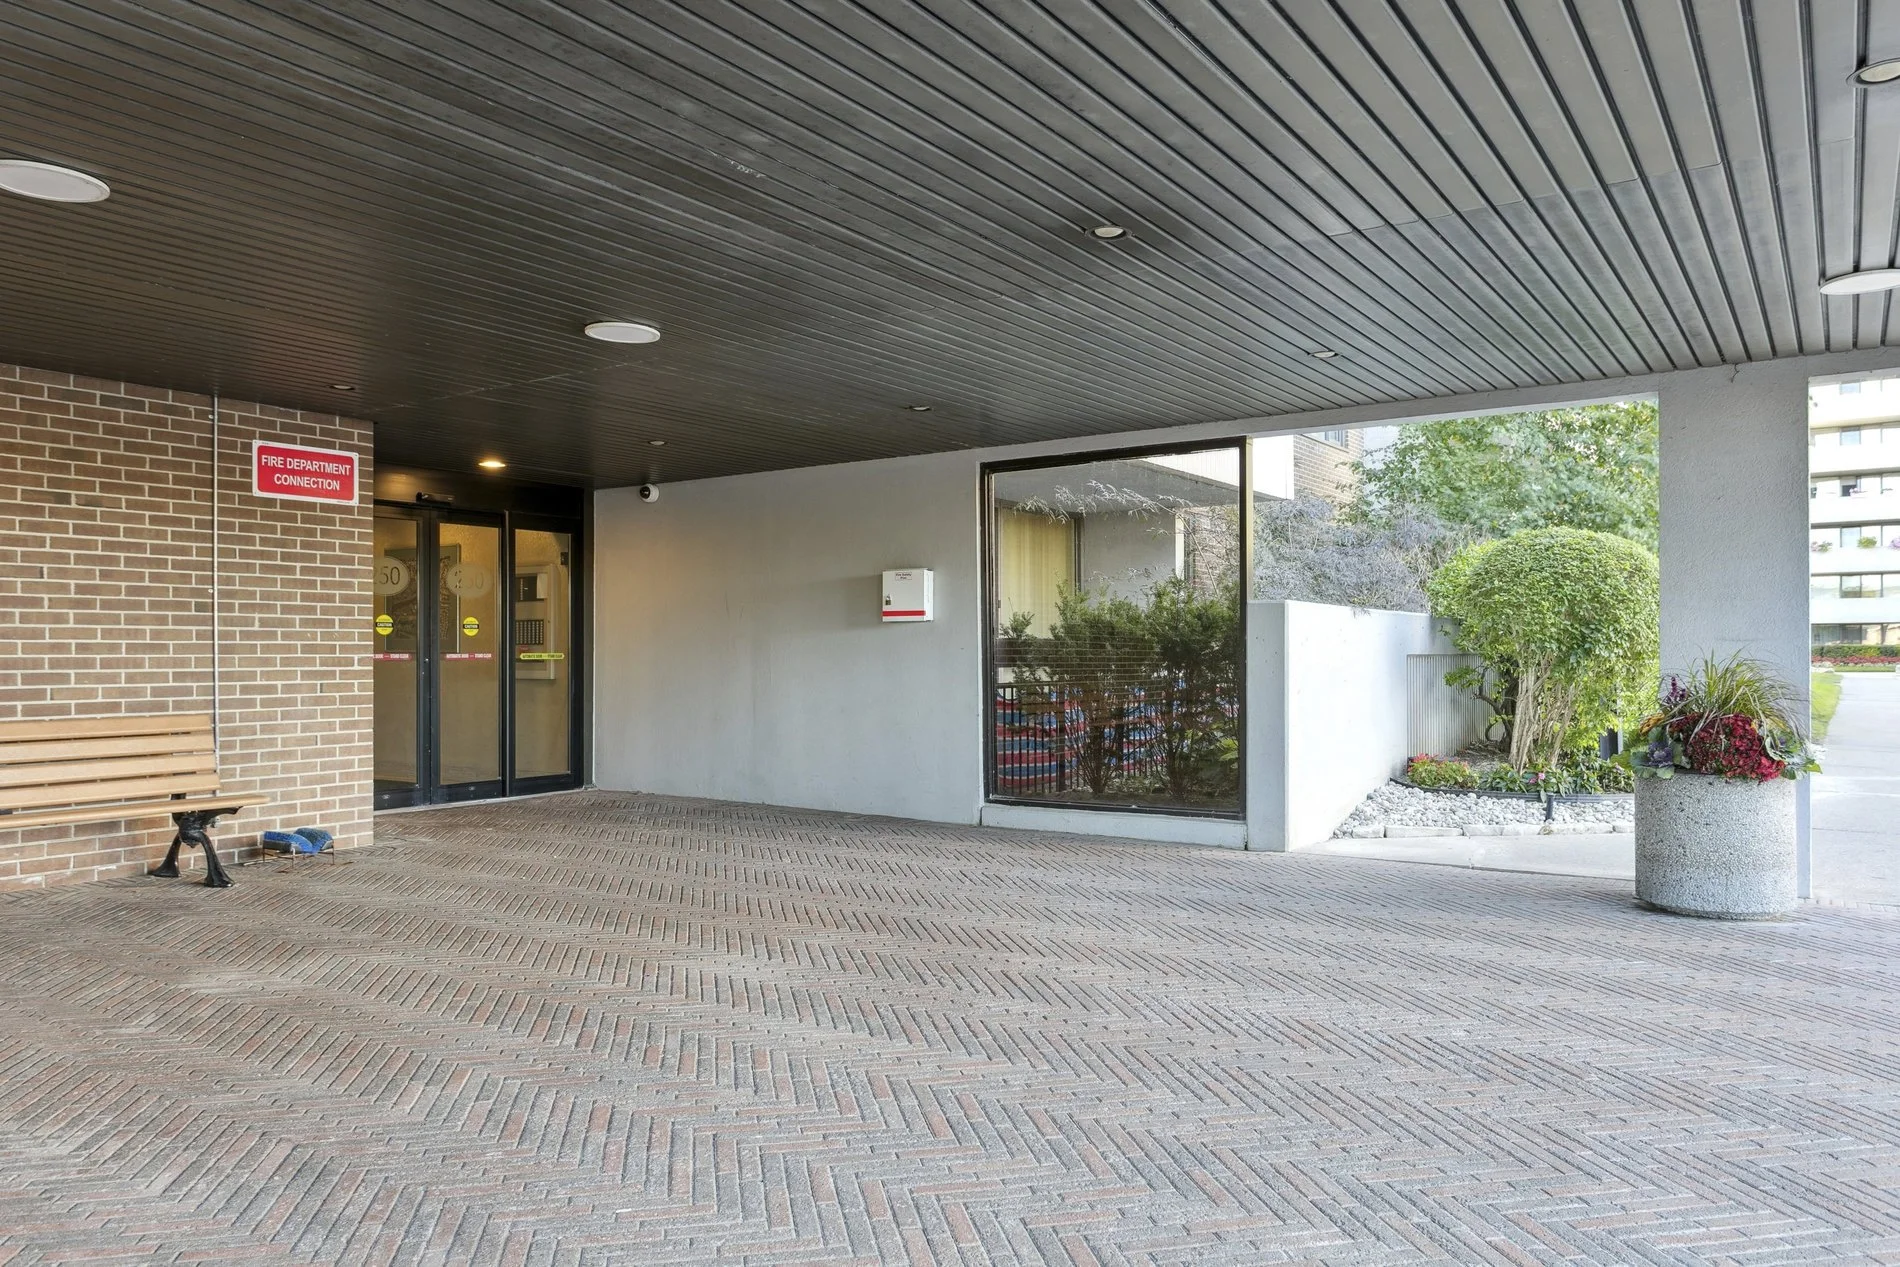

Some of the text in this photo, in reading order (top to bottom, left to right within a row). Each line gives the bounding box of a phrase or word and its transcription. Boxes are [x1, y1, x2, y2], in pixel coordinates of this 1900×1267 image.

[261, 454, 351, 476] FIRE DEPARTMENT
[274, 473, 340, 491] CONNECTION
